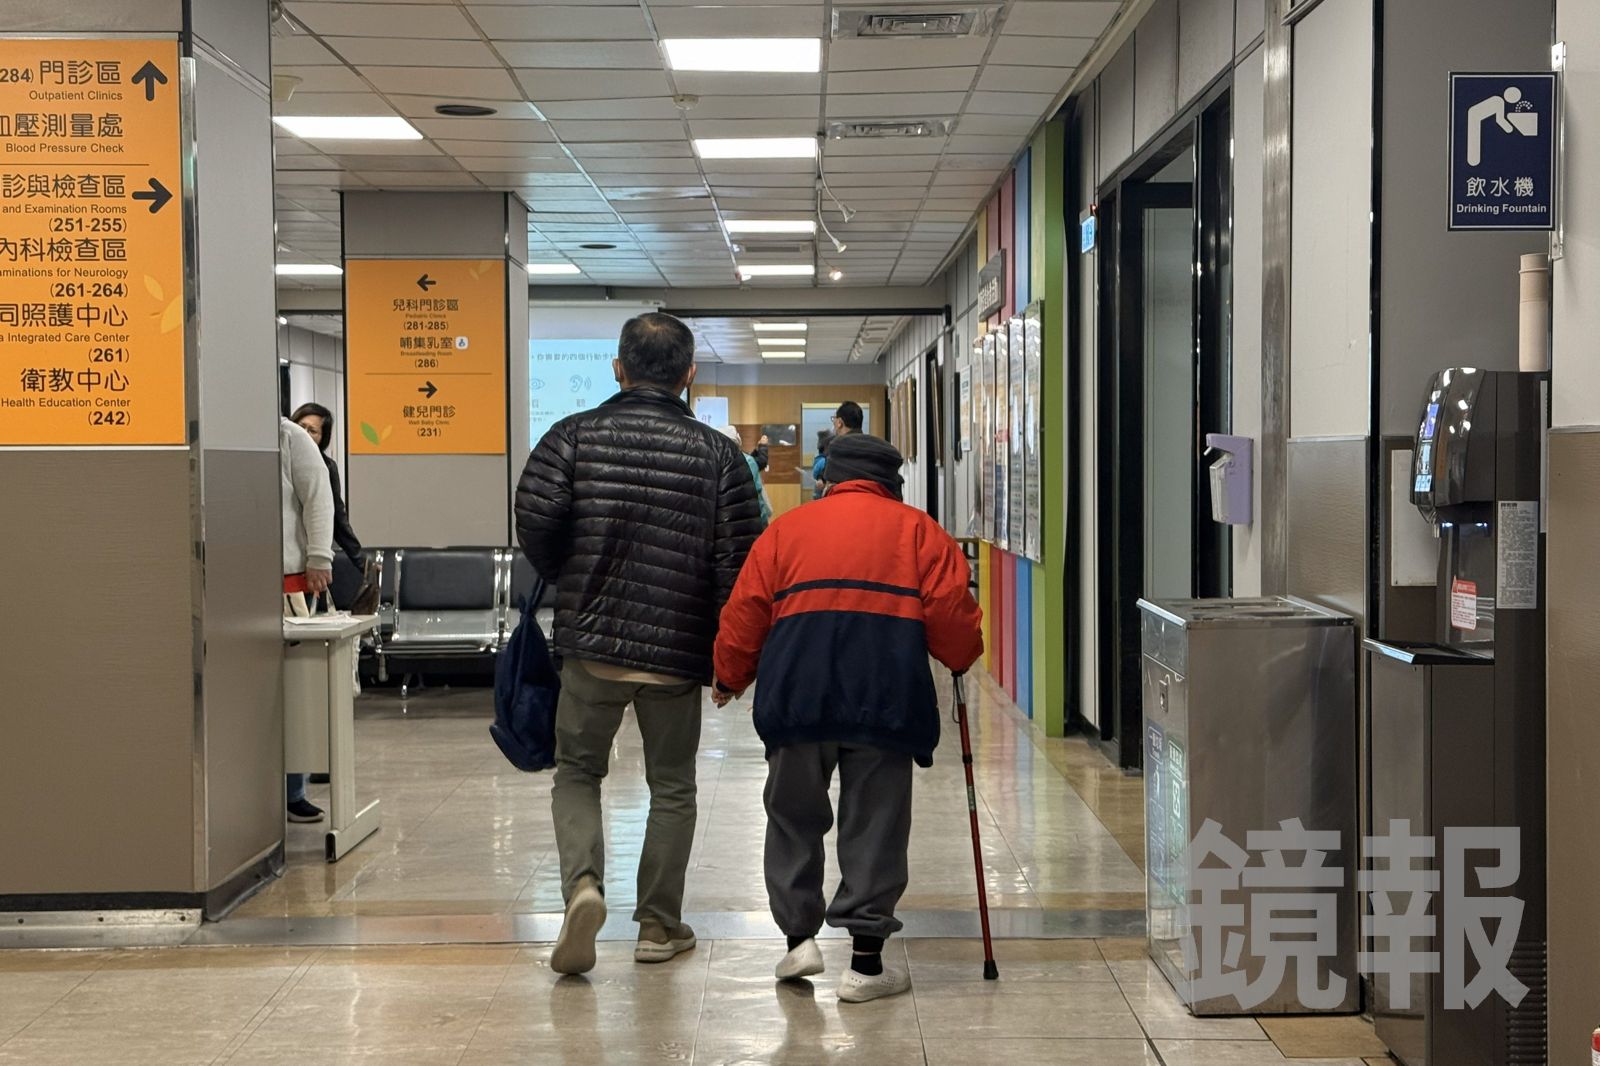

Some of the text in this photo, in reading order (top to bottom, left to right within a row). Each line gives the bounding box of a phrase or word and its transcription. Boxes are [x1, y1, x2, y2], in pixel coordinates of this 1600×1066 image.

[40, 60, 122, 85] 門診區
[29, 90, 123, 102] Outpatient Clinics
[5, 143, 124, 153] Blood Pressure Check
[2, 173, 126, 199] 診與檢查區
[1466, 176, 1535, 198] 飲水機
[2, 203, 128, 214] and Examination Rooms
[1456, 203, 1547, 215] Drinking Fountain
[48, 217, 128, 233] (251-255)
[0, 237, 128, 263] 內科檢查區
[56, 267, 71, 277] for
[74, 267, 129, 279] Neurology
[49, 282, 129, 298] (261-264)
[392, 298, 459, 311] 兒科門診區
[0, 302, 129, 328] 同照護中心
[403, 321, 449, 330] (281-285)
[8, 332, 62, 344] Integrated
[64, 332, 91, 342] Care
[93, 332, 130, 342] Center
[87, 348, 130, 364] (261)
[414, 359, 439, 368] (286)
[20, 367, 130, 393] 衛教中心
[1, 397, 132, 408] Health Education Center
[403, 405, 456, 418] 健兒門診
[87, 411, 131, 427] (242)
[416, 427, 442, 437] (231)
